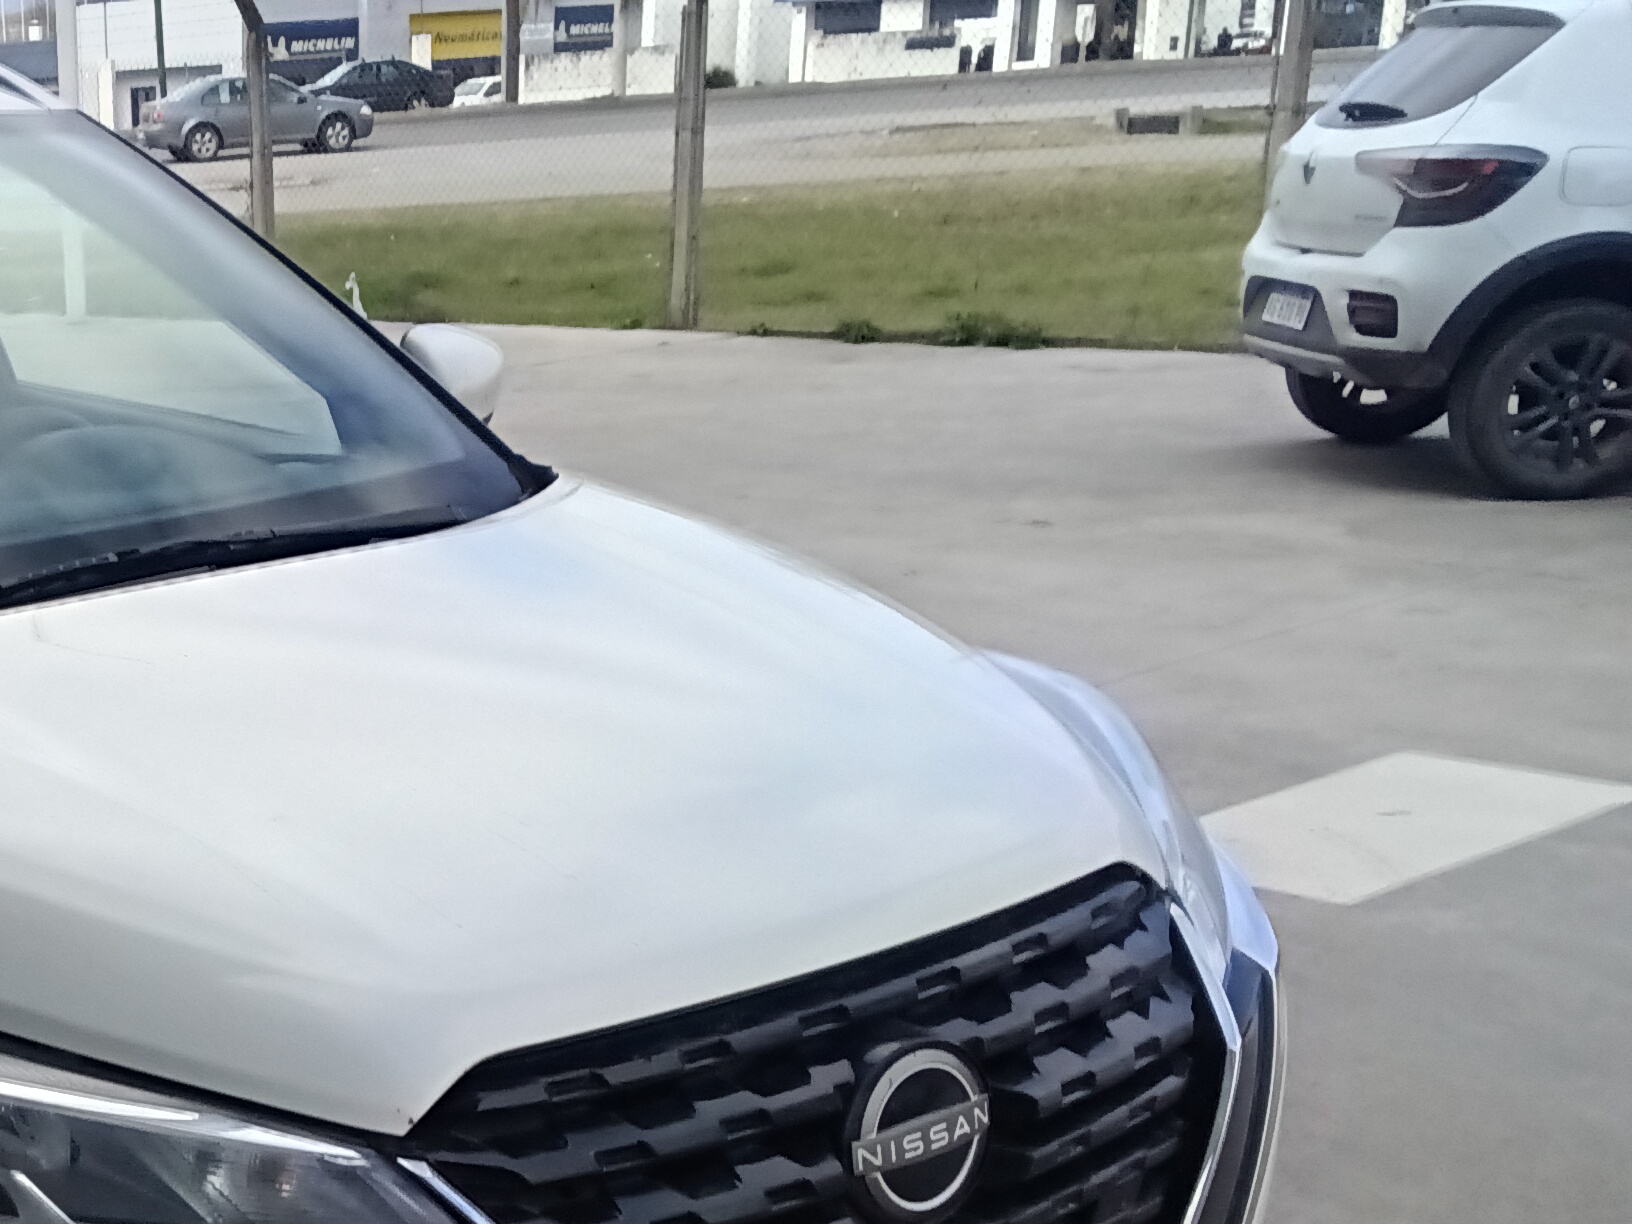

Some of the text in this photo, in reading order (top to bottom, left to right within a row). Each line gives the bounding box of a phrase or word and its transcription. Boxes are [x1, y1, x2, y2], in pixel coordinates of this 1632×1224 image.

[433, 28, 502, 45] Neumático
[569, 22, 614, 35] MICHELI
[290, 36, 356, 53] MICHELIN
[857, 1101, 990, 1172] NISSAN
